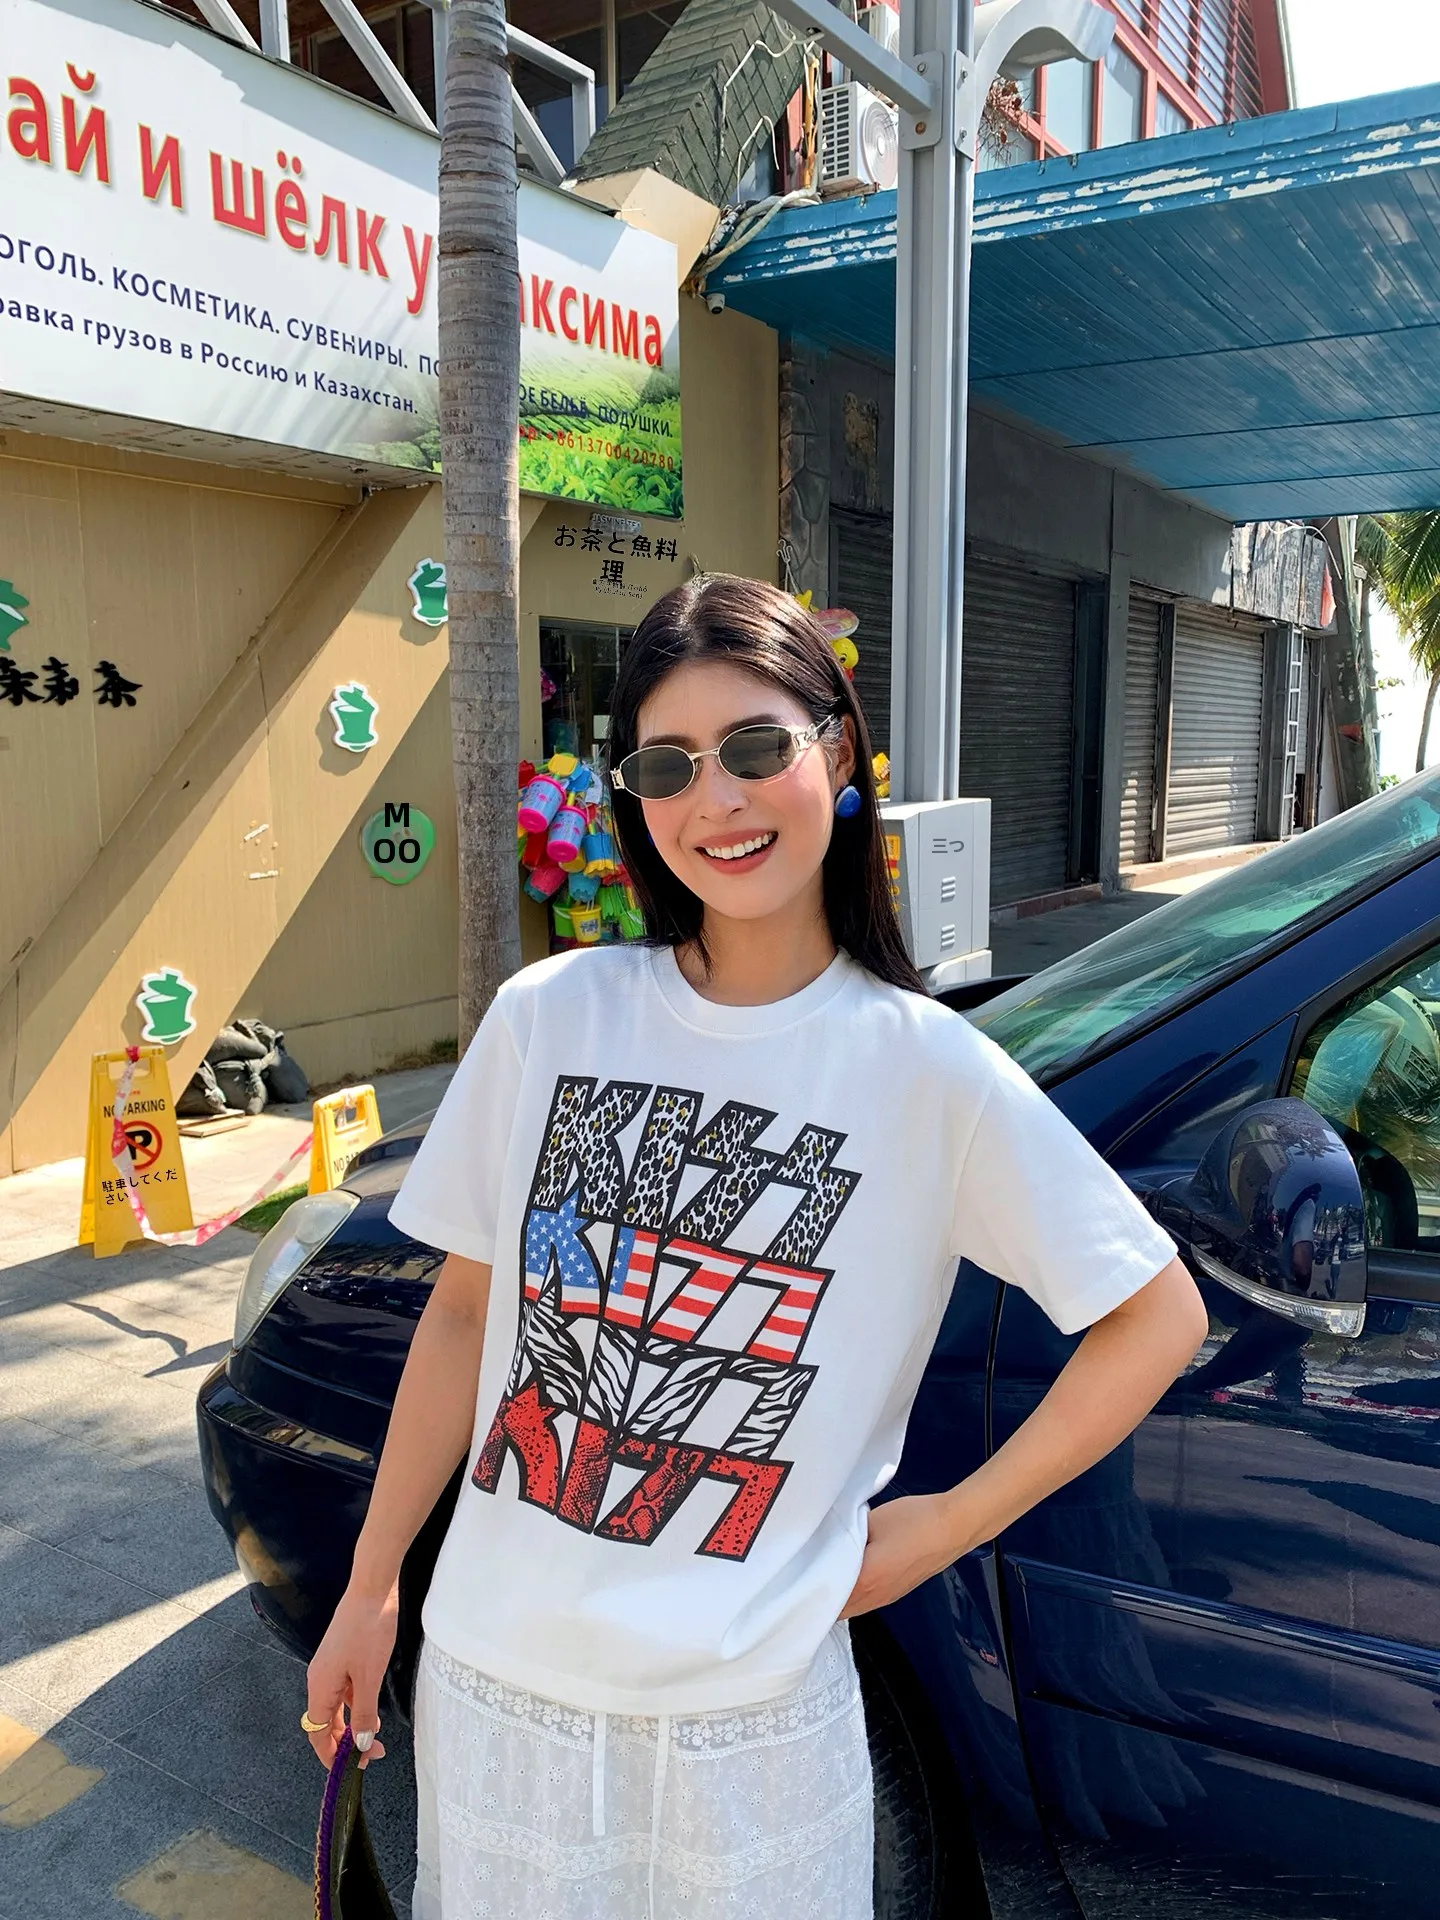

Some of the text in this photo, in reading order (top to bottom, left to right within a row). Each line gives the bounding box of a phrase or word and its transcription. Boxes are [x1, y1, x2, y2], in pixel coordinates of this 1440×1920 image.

[8, 61, 663, 368] ай и шёлк у ксима
[83, 318, 173, 355] грузов
[181, 342, 194, 360] в
[200, 342, 288, 383] Россию
[295, 371, 307, 388] и
[313, 371, 418, 414] Казахстан.
[112, 265, 280, 334] КОСМЕТИКА.
[286, 317, 408, 369] СУВЕНИРЫ.
[598, 404, 673, 438] ПОДУШКИ.
[554, 524, 678, 562] お茶と魚料
[384, 802, 410, 828] M
[122, 1098, 166, 1117] ARKING
[101, 1168, 178, 1193] 駐車してくだ
[105, 1191, 129, 1206] さい
